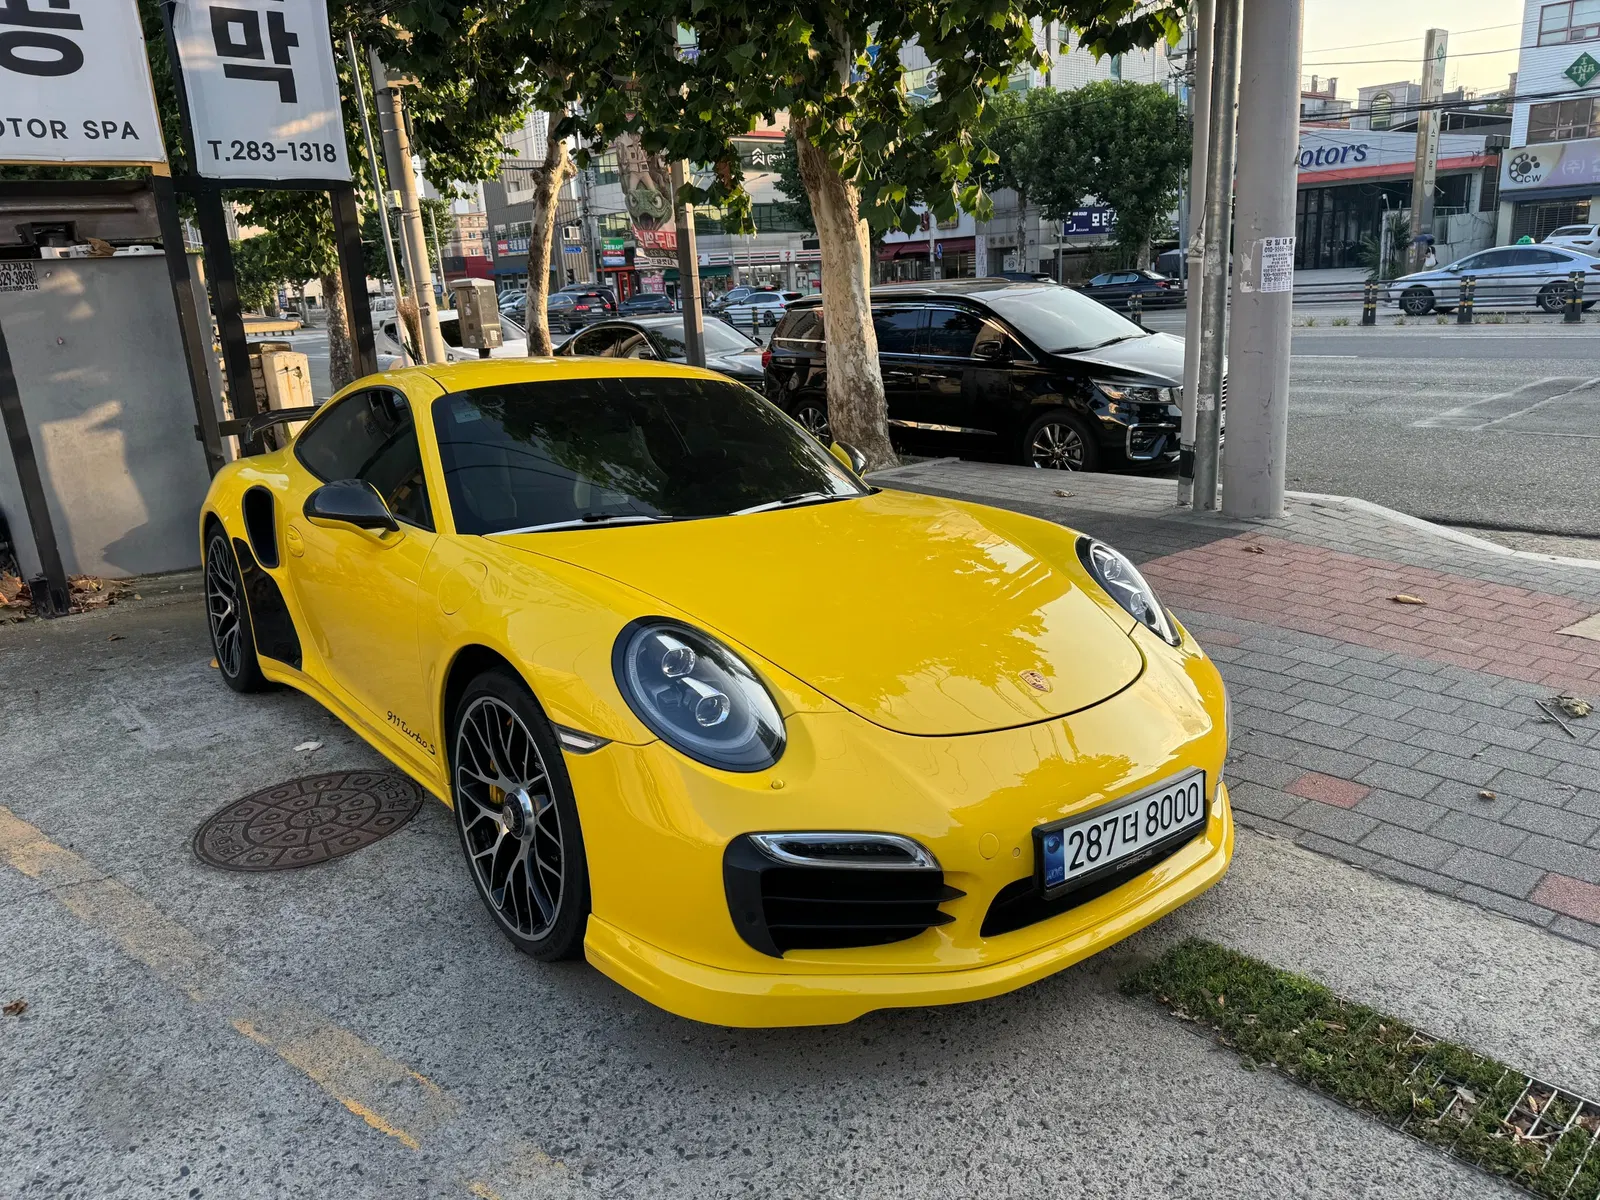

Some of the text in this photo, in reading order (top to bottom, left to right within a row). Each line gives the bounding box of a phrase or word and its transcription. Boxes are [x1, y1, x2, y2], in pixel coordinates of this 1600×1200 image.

[0, 118, 140, 140] TOR SPA
[207, 140, 337, 163] T.283-1318
[1300, 143, 1369, 168] otors
[387, 710, 436, 756] 911 Turbo S
[1069, 782, 1199, 872] 287더 8000
